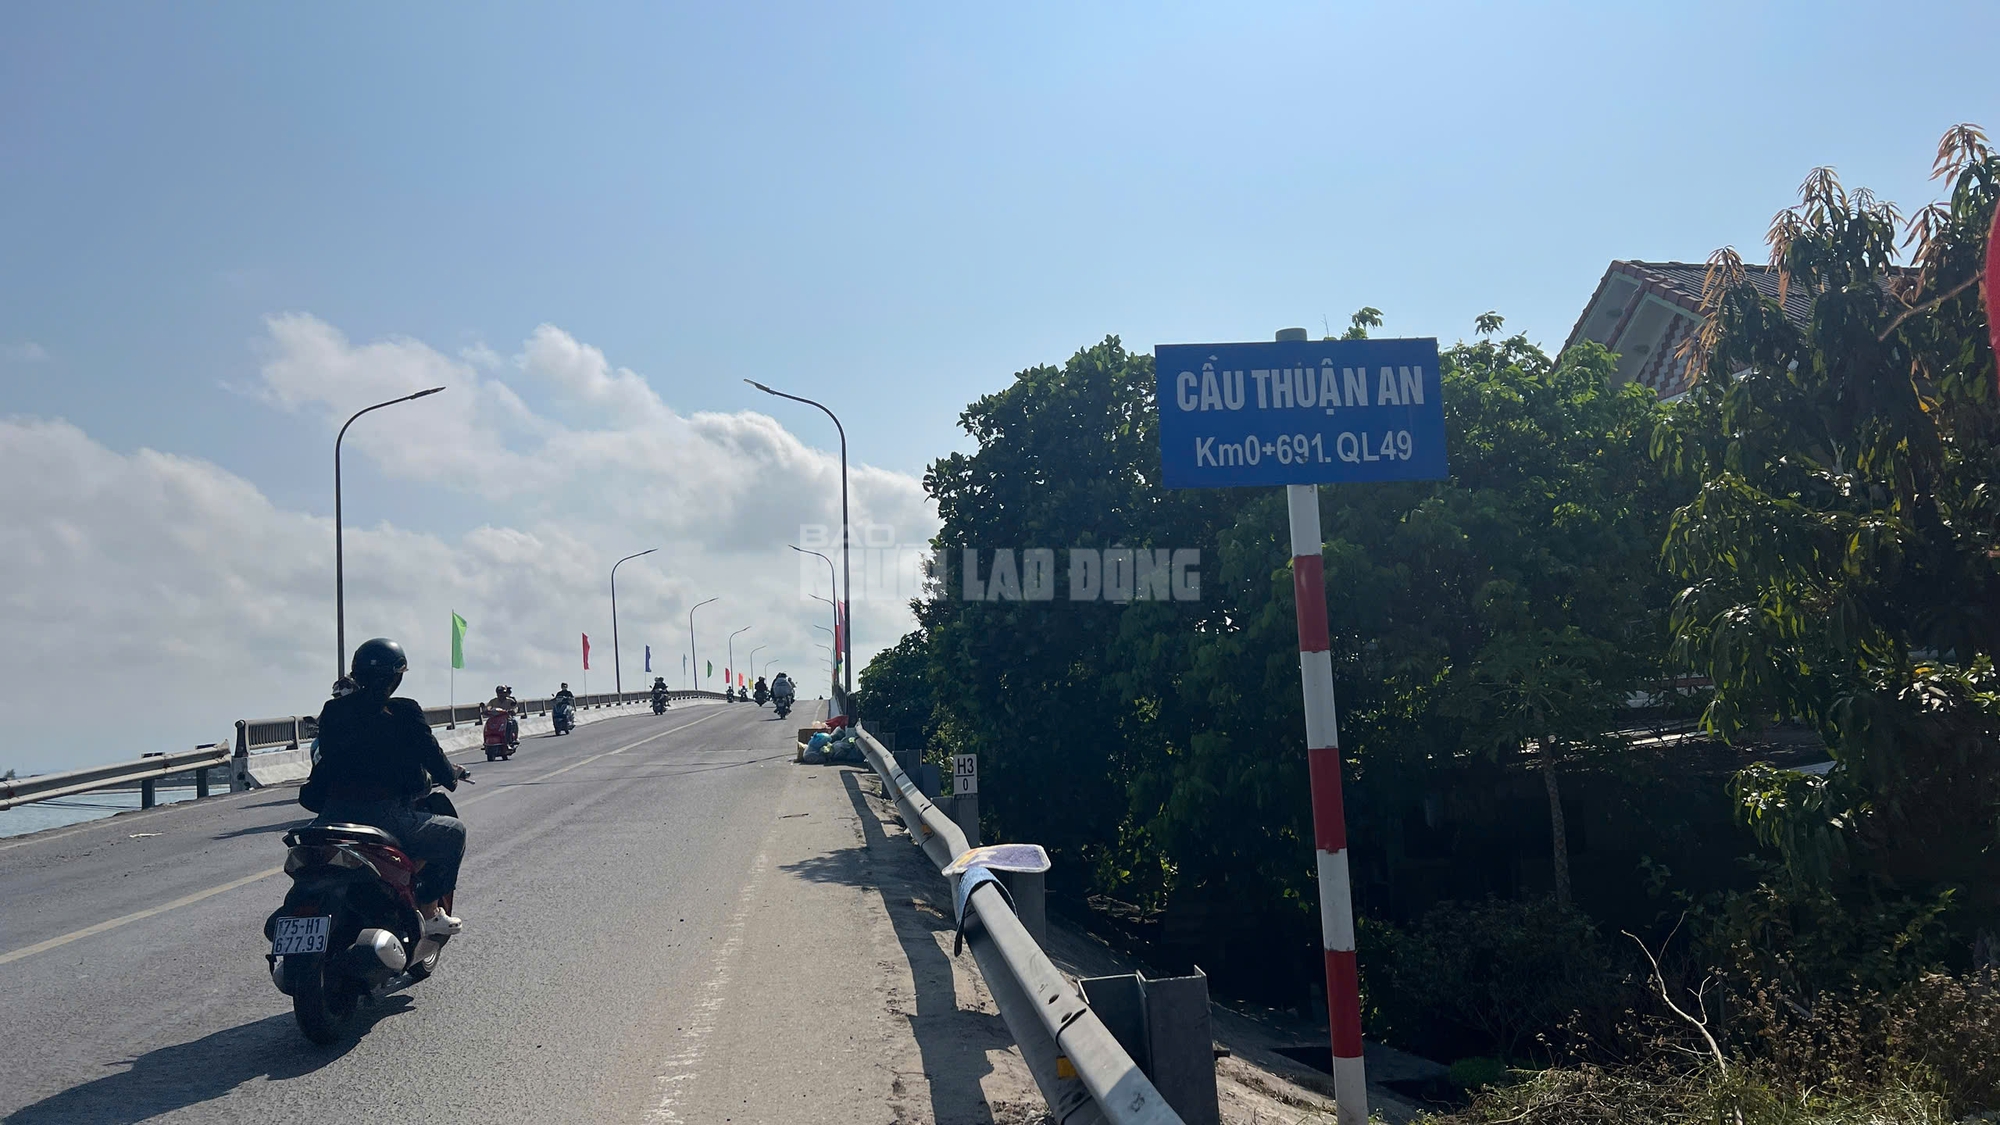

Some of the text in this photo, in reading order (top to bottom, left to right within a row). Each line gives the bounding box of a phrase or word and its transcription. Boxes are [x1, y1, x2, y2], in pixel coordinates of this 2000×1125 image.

[1176, 355, 1425, 415] CẦU THUẬN AN
[957, 757, 974, 774] H3
[962, 777, 969, 791] 0
[283, 918, 321, 935] 75-H1
[275, 935, 325, 953] 677.93
